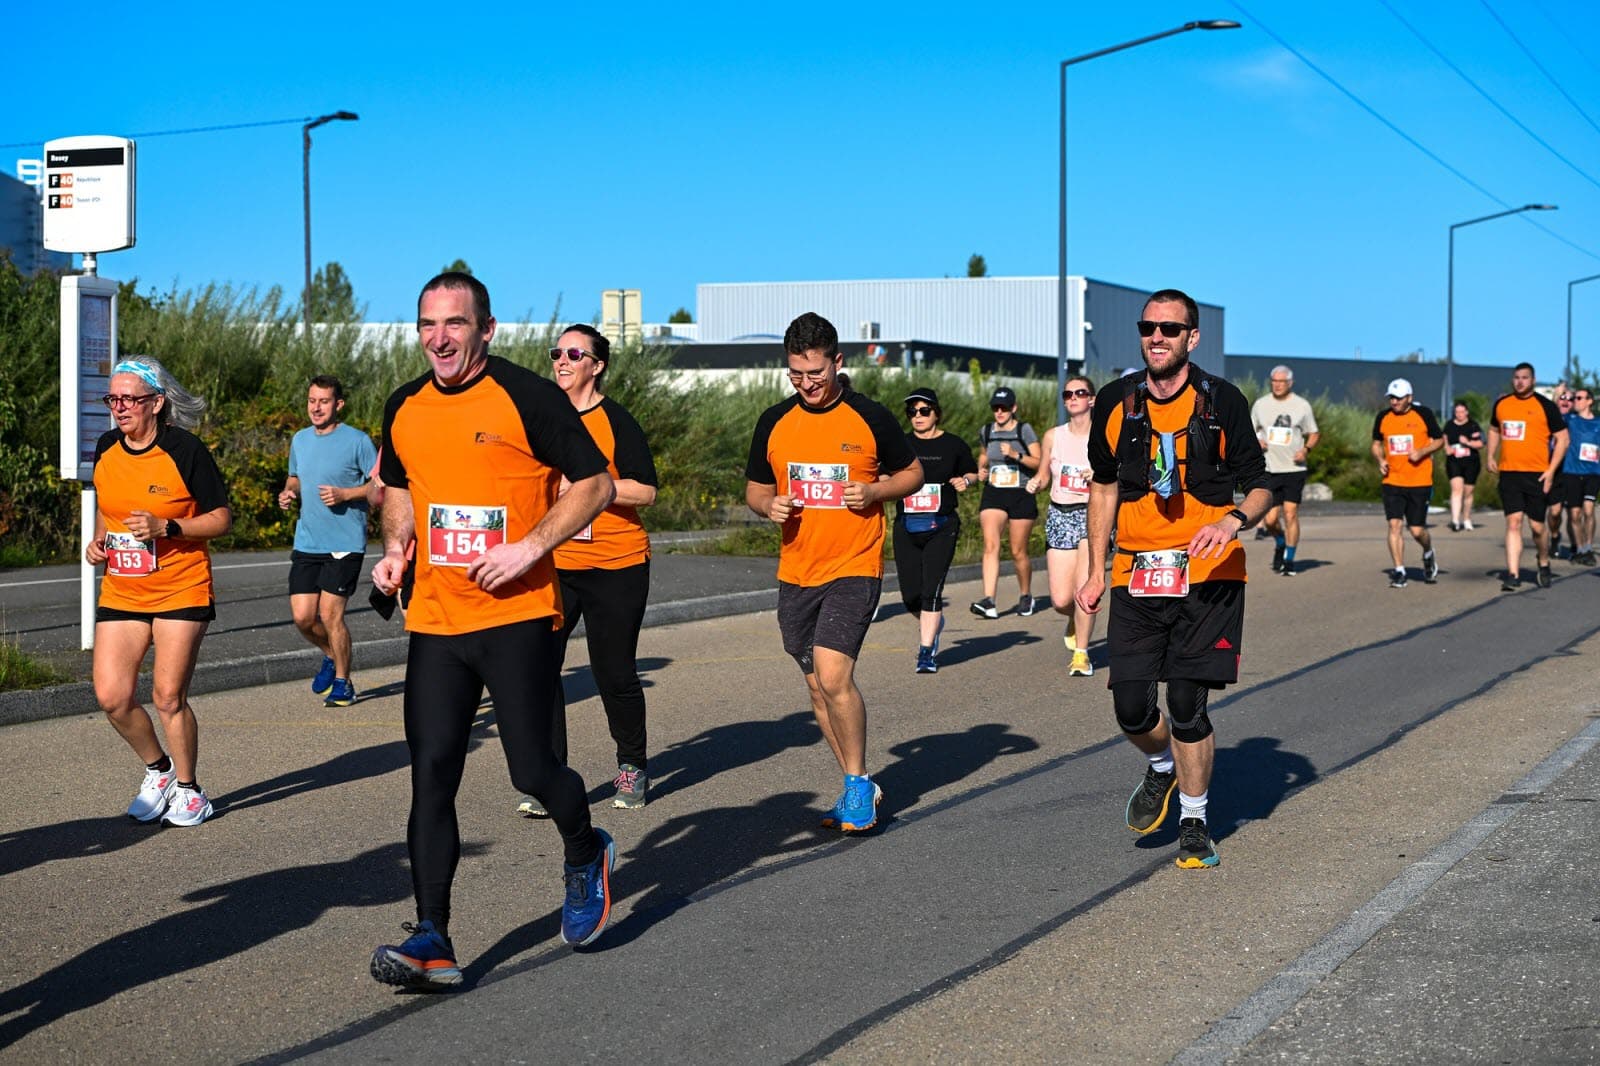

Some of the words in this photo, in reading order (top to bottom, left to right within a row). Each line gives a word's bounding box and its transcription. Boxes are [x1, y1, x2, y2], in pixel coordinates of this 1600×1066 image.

[51, 175, 59, 186] F
[60, 175, 73, 185] 40
[51, 196, 59, 207] F
[60, 196, 73, 206] 40
[801, 482, 833, 500] 162
[443, 532, 487, 555] 154
[115, 552, 142, 569] 153
[1144, 570, 1174, 588] 156
